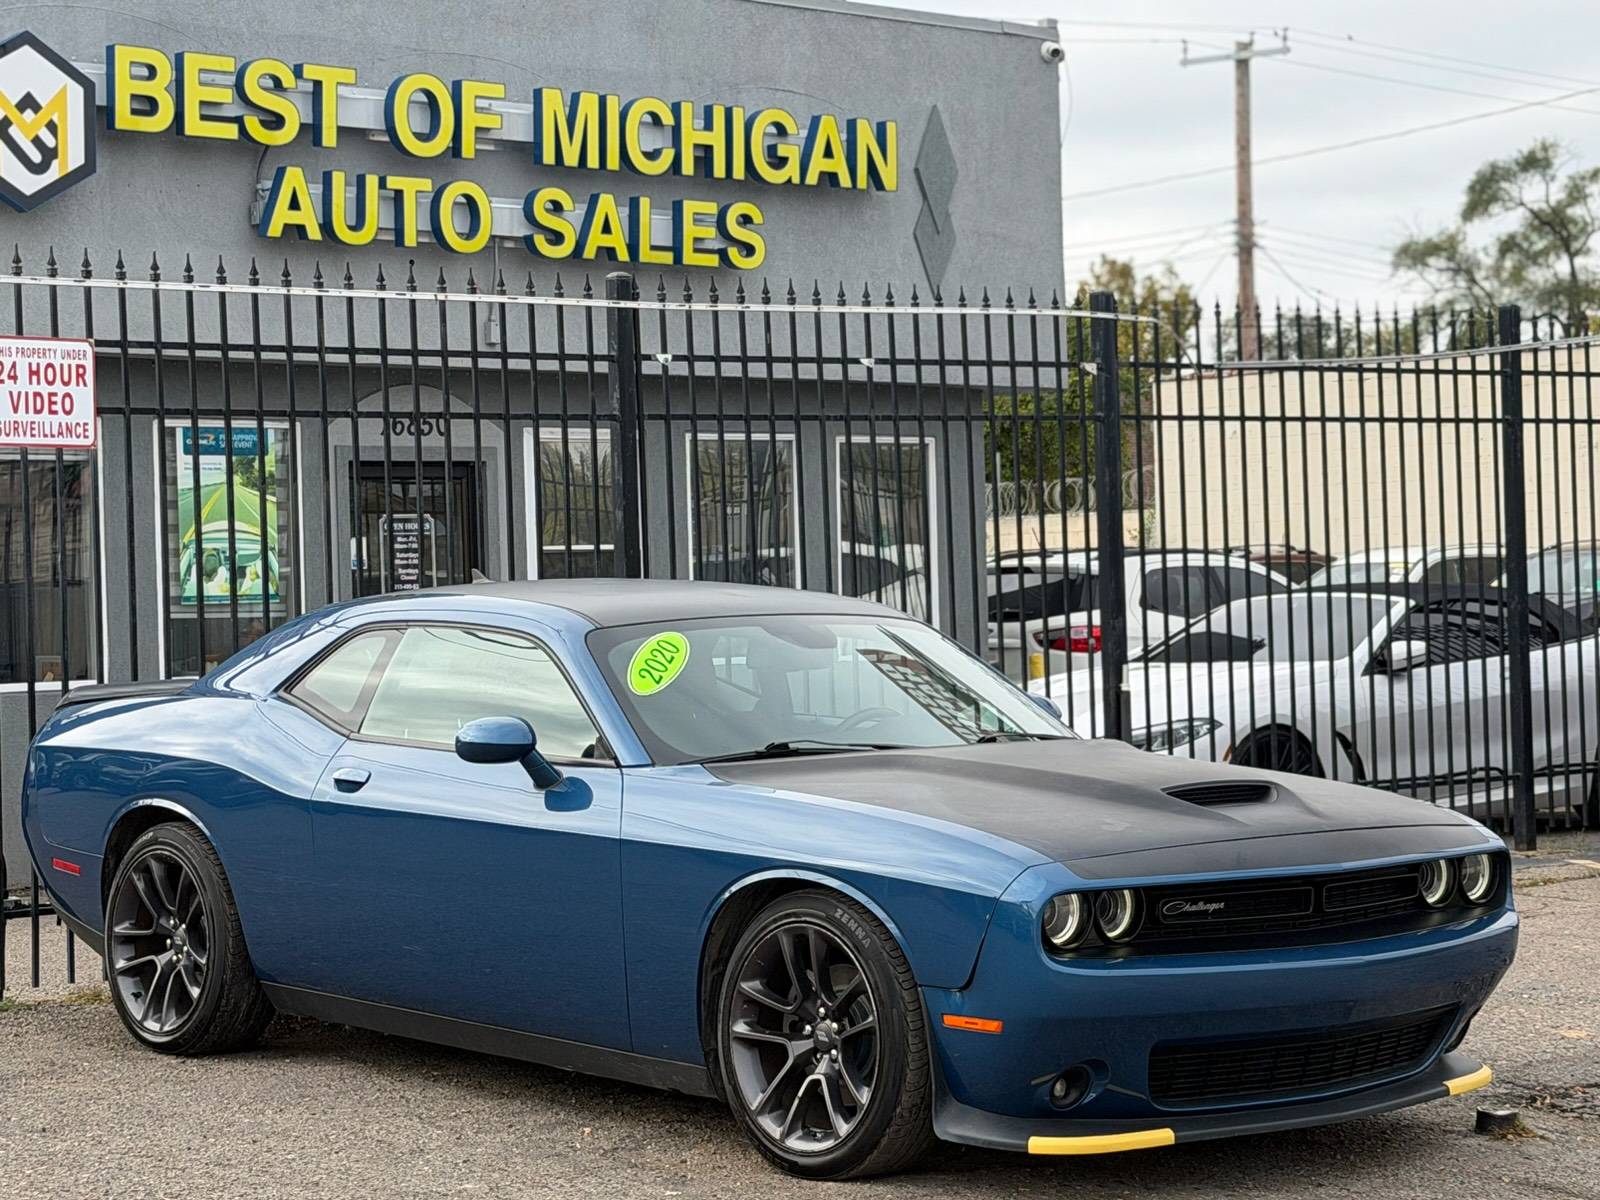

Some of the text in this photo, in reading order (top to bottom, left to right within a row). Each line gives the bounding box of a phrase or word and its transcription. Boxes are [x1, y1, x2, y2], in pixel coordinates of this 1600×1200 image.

[106, 44, 898, 192] BEST OF MICHIGAN
[260, 166, 766, 270] AUTO SALES
[0, 345, 88, 361] HIS PROPERTY UNDER
[28, 362, 88, 387] HOUR
[8, 390, 74, 416] VIDEO
[638, 639, 680, 685] 2020
[1162, 901, 1225, 915] Challenger
[834, 908, 871, 949] ZENNA
